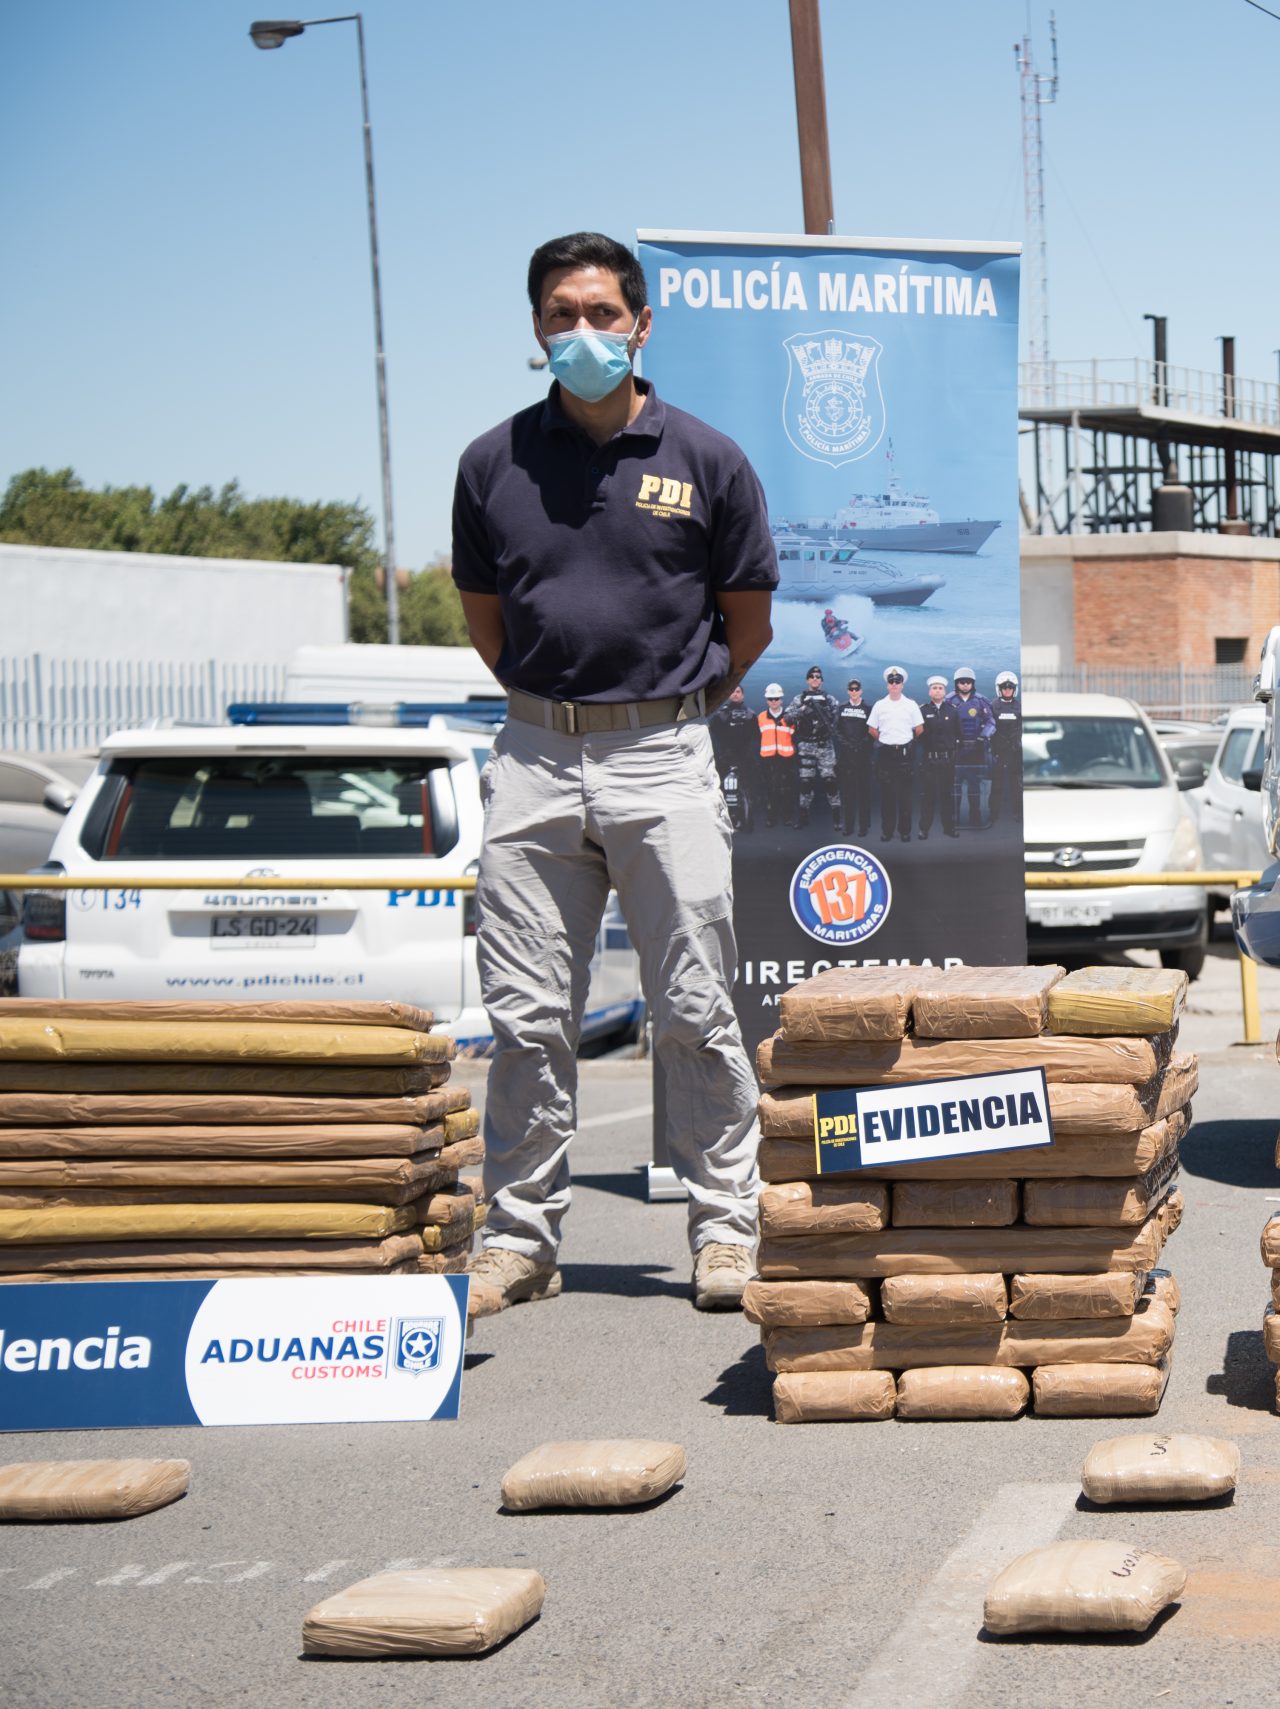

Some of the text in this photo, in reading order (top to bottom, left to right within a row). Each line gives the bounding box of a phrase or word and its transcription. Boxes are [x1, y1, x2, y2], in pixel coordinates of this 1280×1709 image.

[659, 261, 998, 317] POLICÍA MARÍTIMA
[638, 474, 693, 508] PDI
[799, 850, 879, 889] EMERGENCIAS
[808, 870, 867, 925] 137
[813, 903, 884, 940] MARITIMAS
[819, 1091, 1043, 1144] PDI EVIDENCIA
[332, 1319, 387, 1334] CHILE
[0, 1325, 151, 1372] encia
[200, 1335, 385, 1364] ADUANAS
[291, 1364, 383, 1380] CUSTOMS
